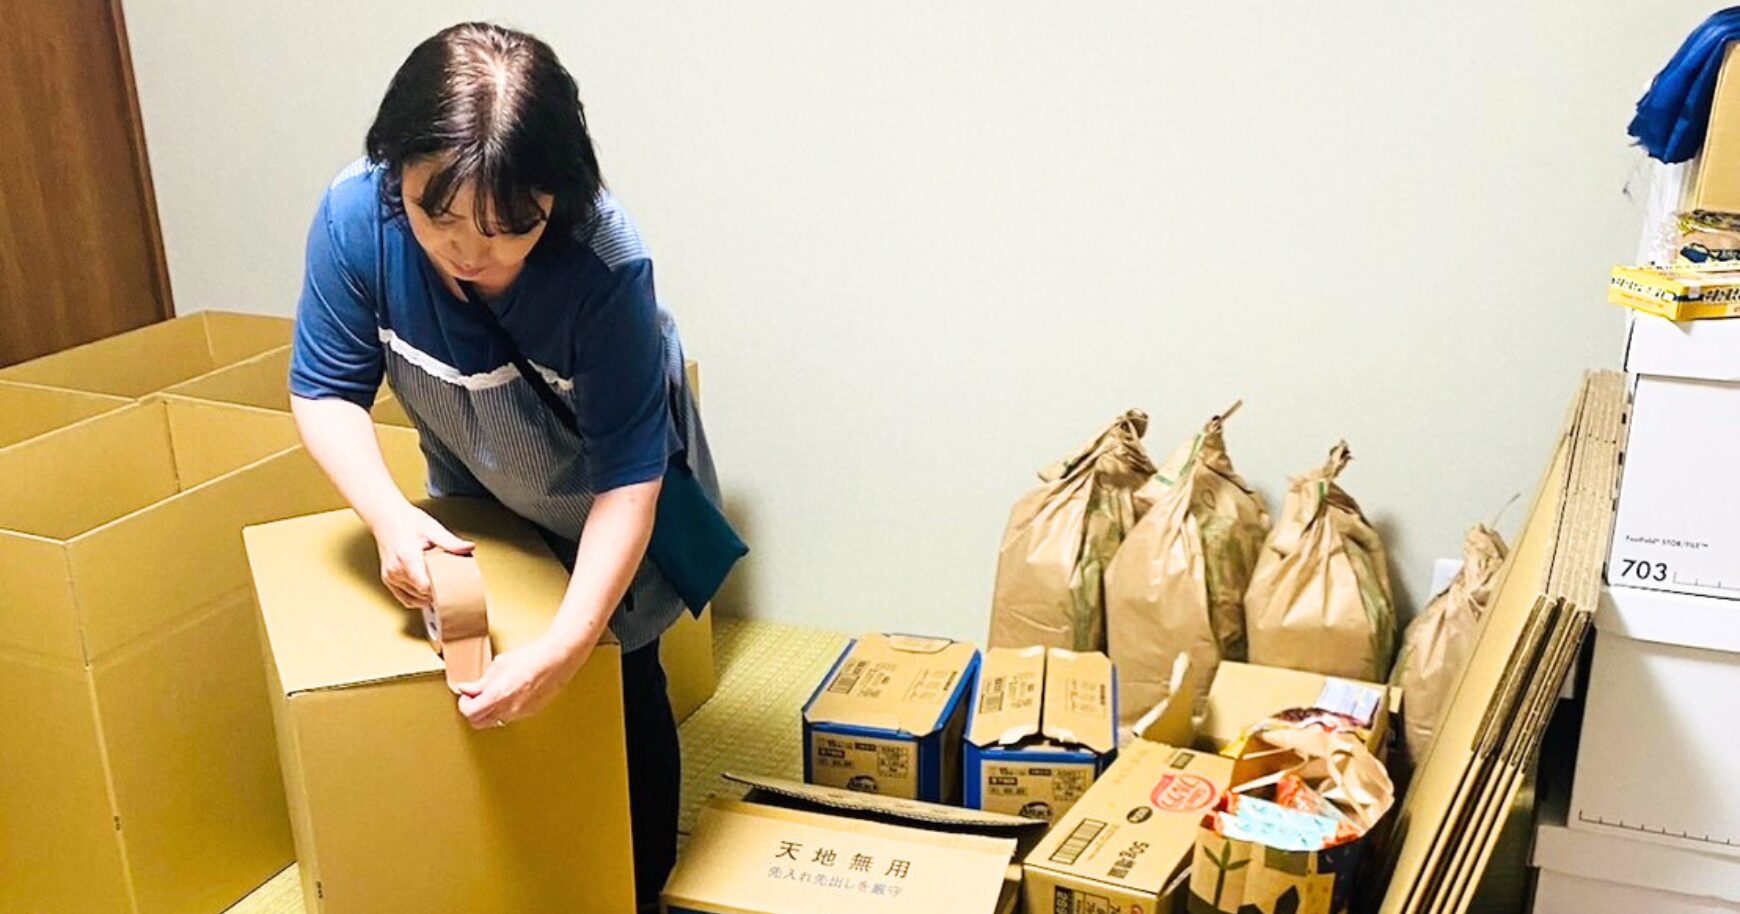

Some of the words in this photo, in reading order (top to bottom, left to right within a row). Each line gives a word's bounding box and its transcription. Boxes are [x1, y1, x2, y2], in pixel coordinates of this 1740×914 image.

[1621, 558, 1668, 582] 703
[774, 840, 911, 879] 天地無用
[767, 866, 903, 898] 先入れ先出しを厳守
